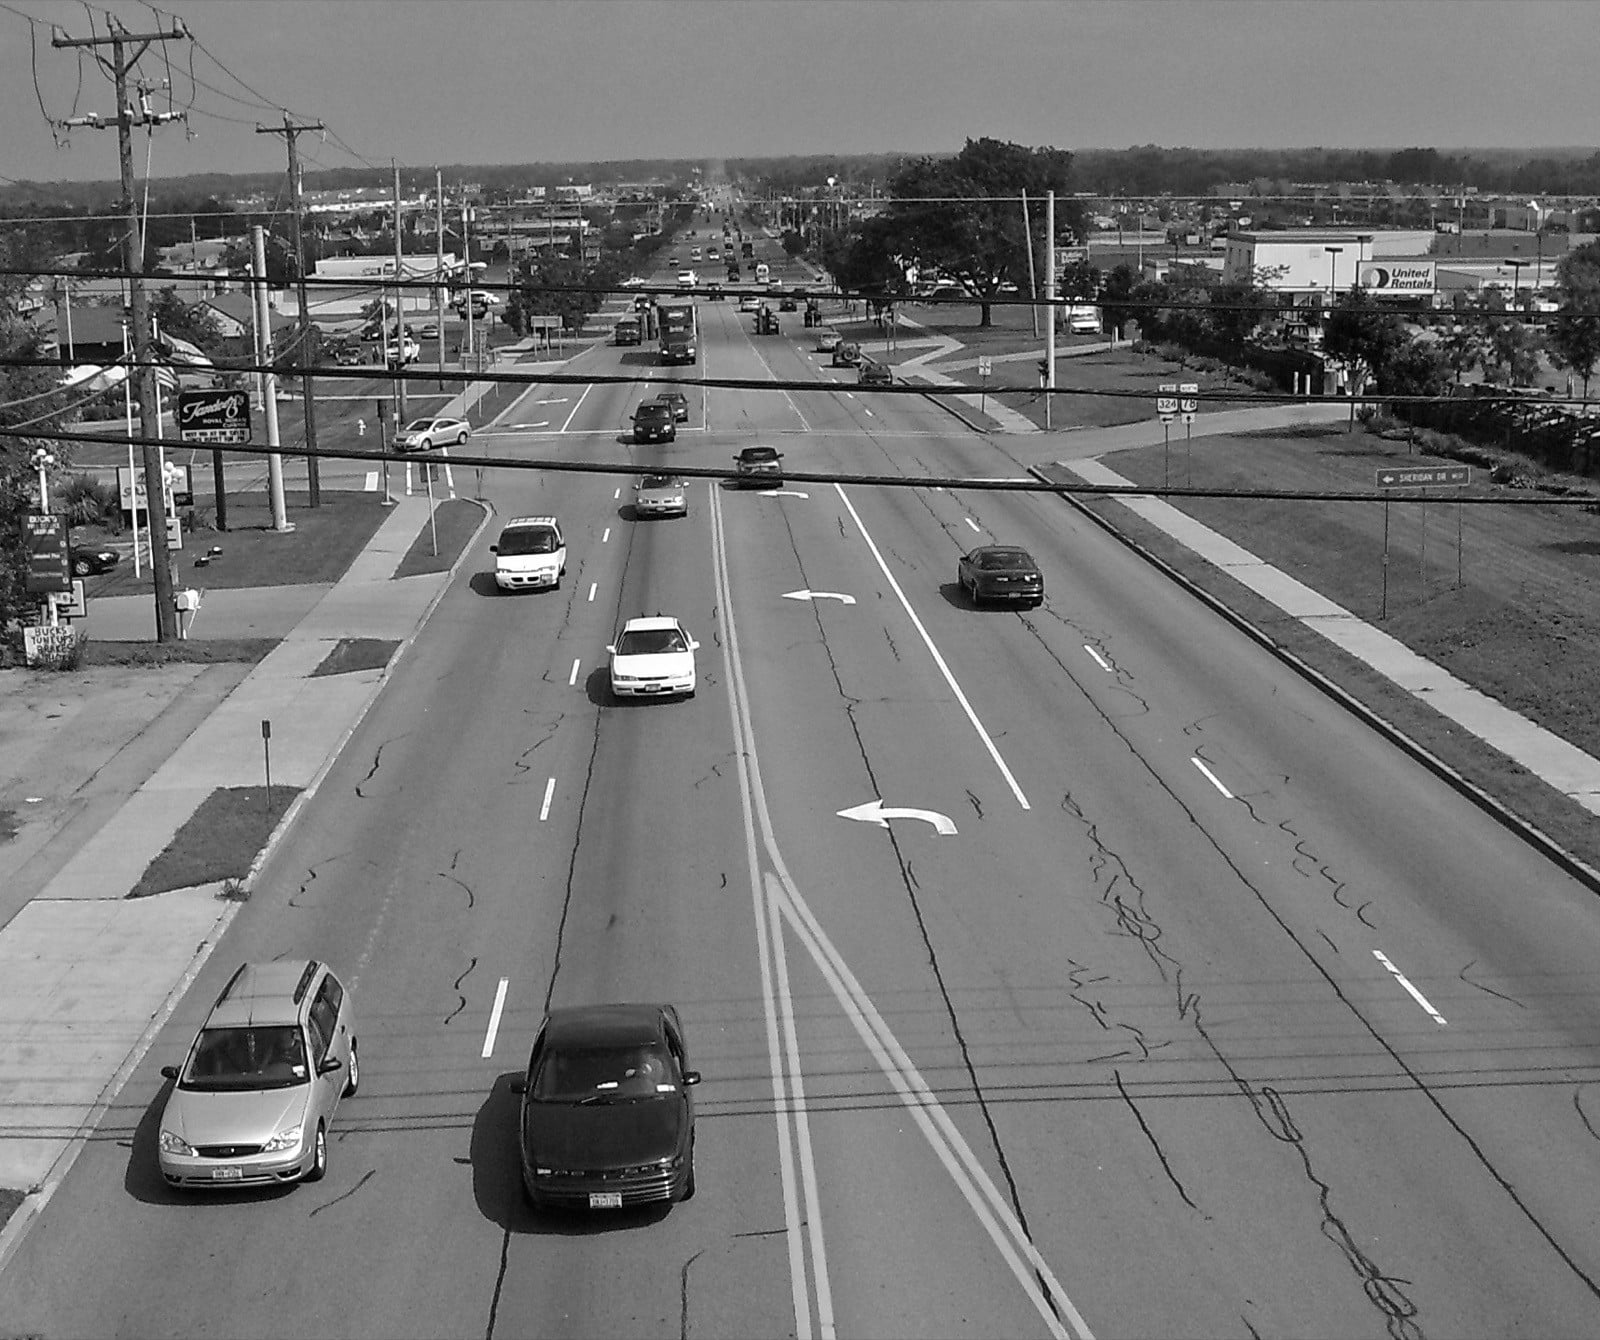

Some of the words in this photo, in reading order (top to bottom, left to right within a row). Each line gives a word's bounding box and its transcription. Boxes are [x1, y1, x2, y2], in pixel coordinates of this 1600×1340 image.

[1392, 268, 1430, 278] United
[1391, 278, 1433, 289] Rentals
[1159, 400, 1176, 408] 324
[1183, 399, 1196, 408] 78
[1399, 473, 1432, 483] SHERIDAN
[35, 626, 68, 637] BUCKS
